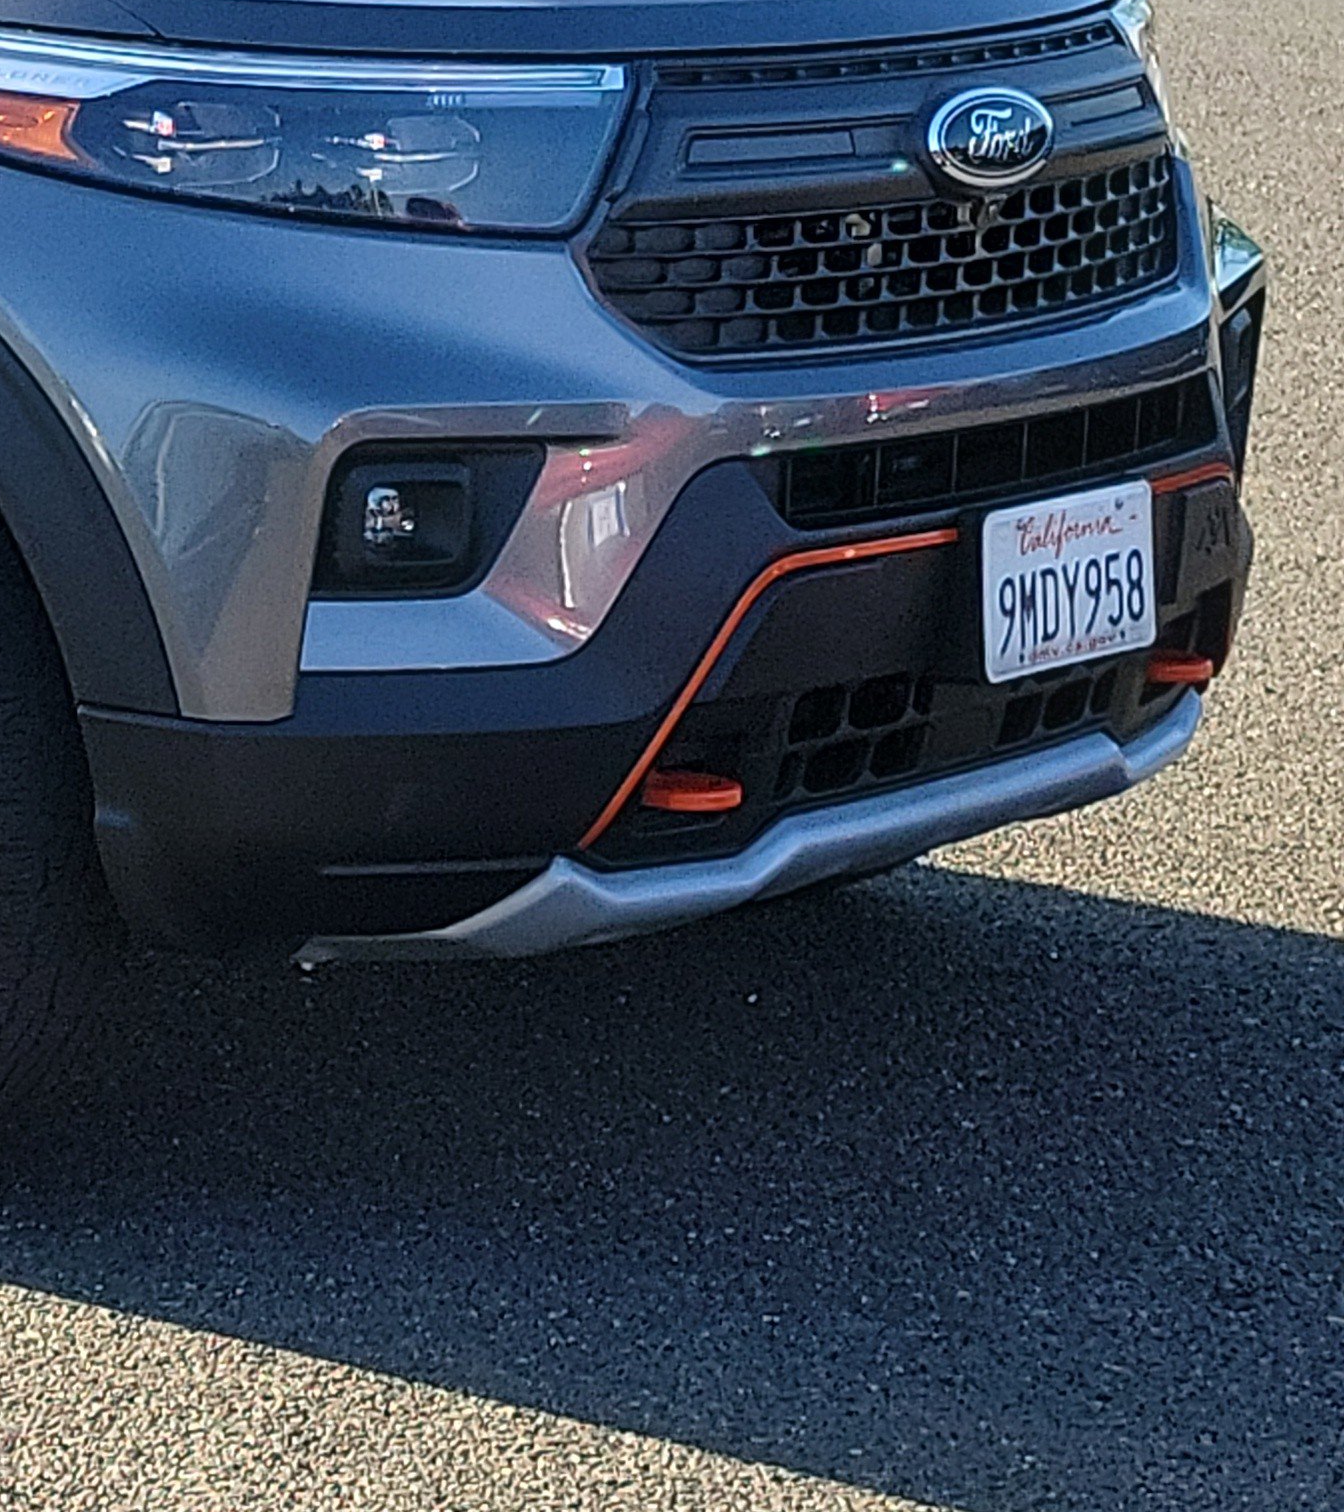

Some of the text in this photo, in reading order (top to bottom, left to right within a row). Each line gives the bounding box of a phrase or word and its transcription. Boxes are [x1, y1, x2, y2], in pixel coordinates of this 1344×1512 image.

[968, 107, 1035, 163] Ford
[1015, 508, 1124, 559] California
[998, 547, 1146, 659] 9MDY958
